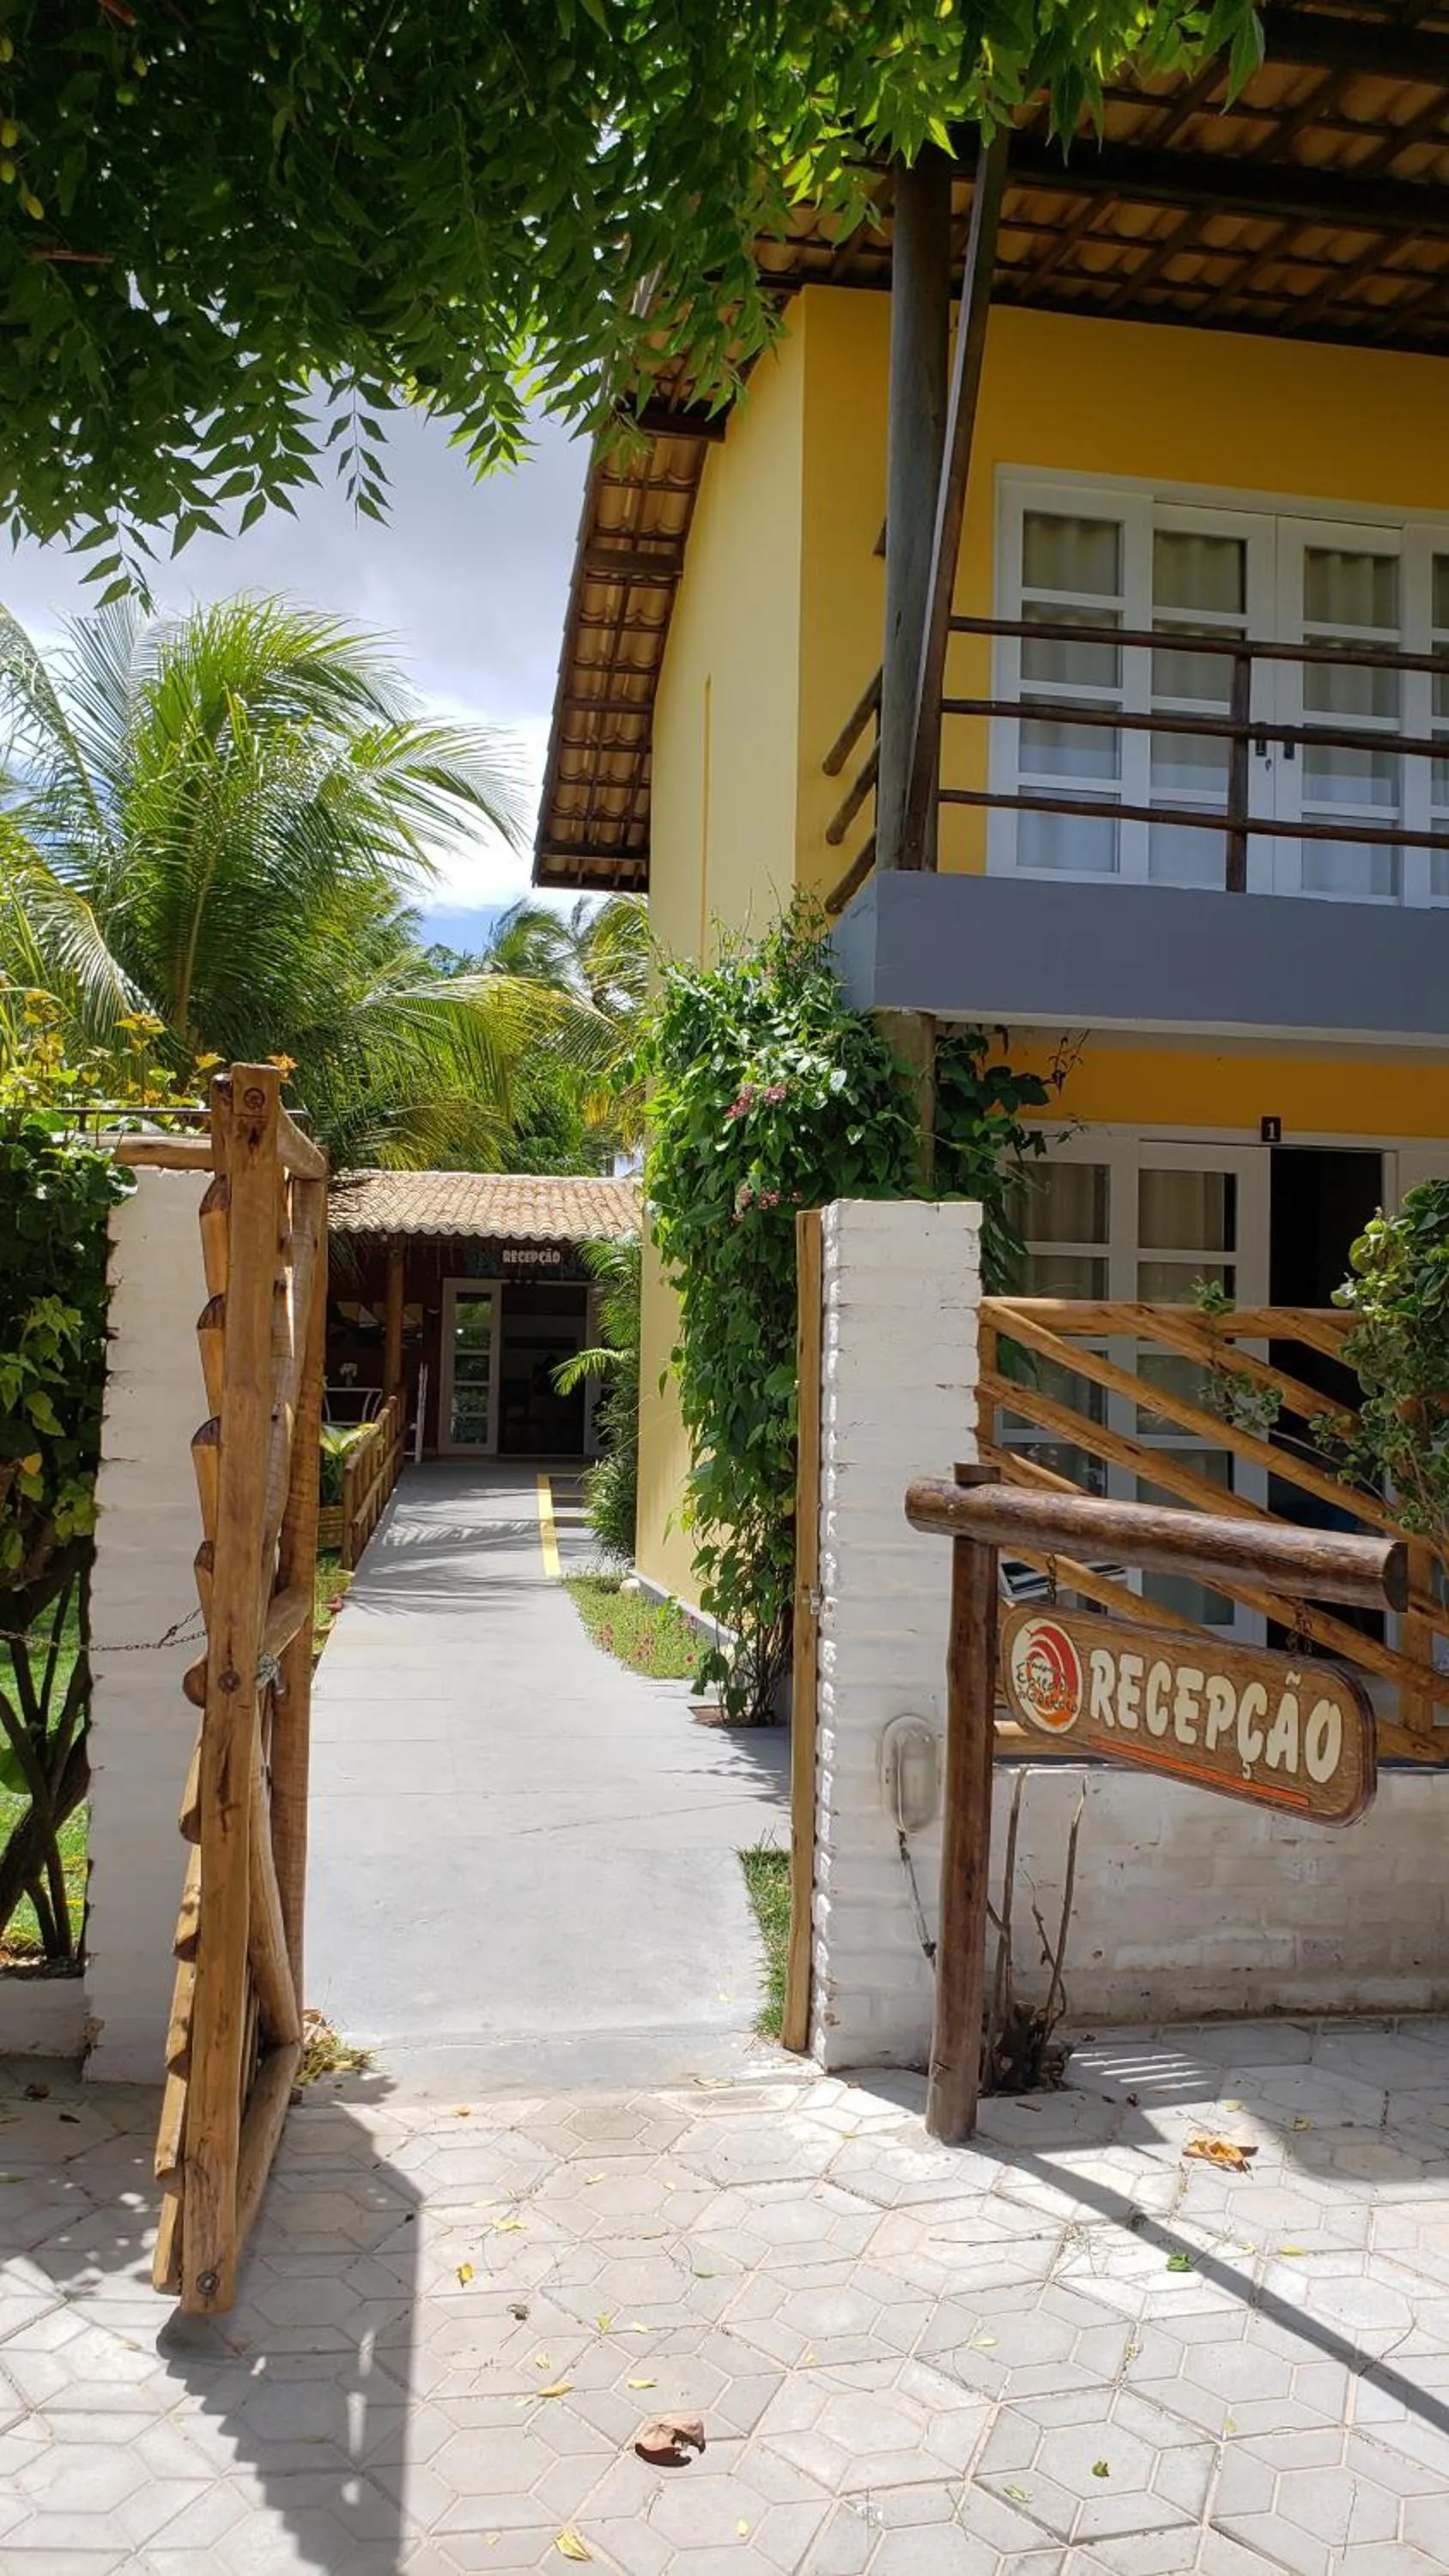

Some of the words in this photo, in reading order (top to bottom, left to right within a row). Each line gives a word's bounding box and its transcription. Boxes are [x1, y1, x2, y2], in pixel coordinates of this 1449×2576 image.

[1266, 1121, 1277, 1139] 1
[502, 1248, 561, 1265] RECEPÇÃO
[1089, 1649, 1343, 1783] RECEPÇÃO
